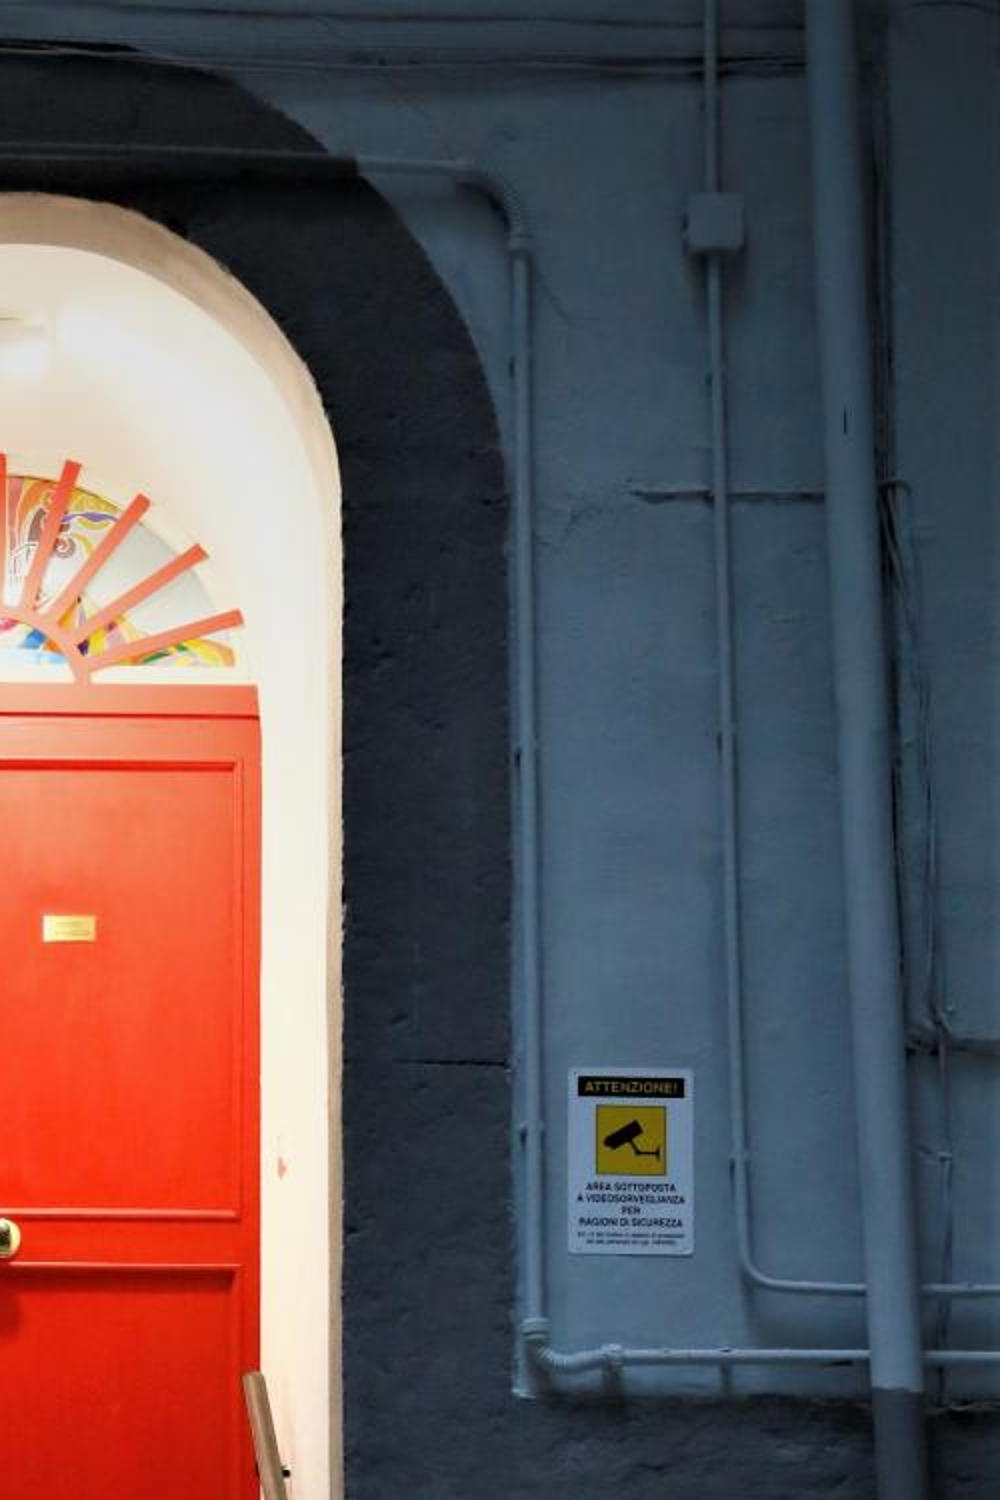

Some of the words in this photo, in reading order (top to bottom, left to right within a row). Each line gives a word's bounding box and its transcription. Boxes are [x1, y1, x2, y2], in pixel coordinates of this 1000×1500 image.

[583, 1081, 679, 1095] ATTENZIONE!
[585, 1182, 612, 1192] AREA
[614, 1183, 677, 1193] SOTTOPOSTA
[621, 1206, 641, 1216] PER
[631, 1217, 683, 1229] SICUREZZA
